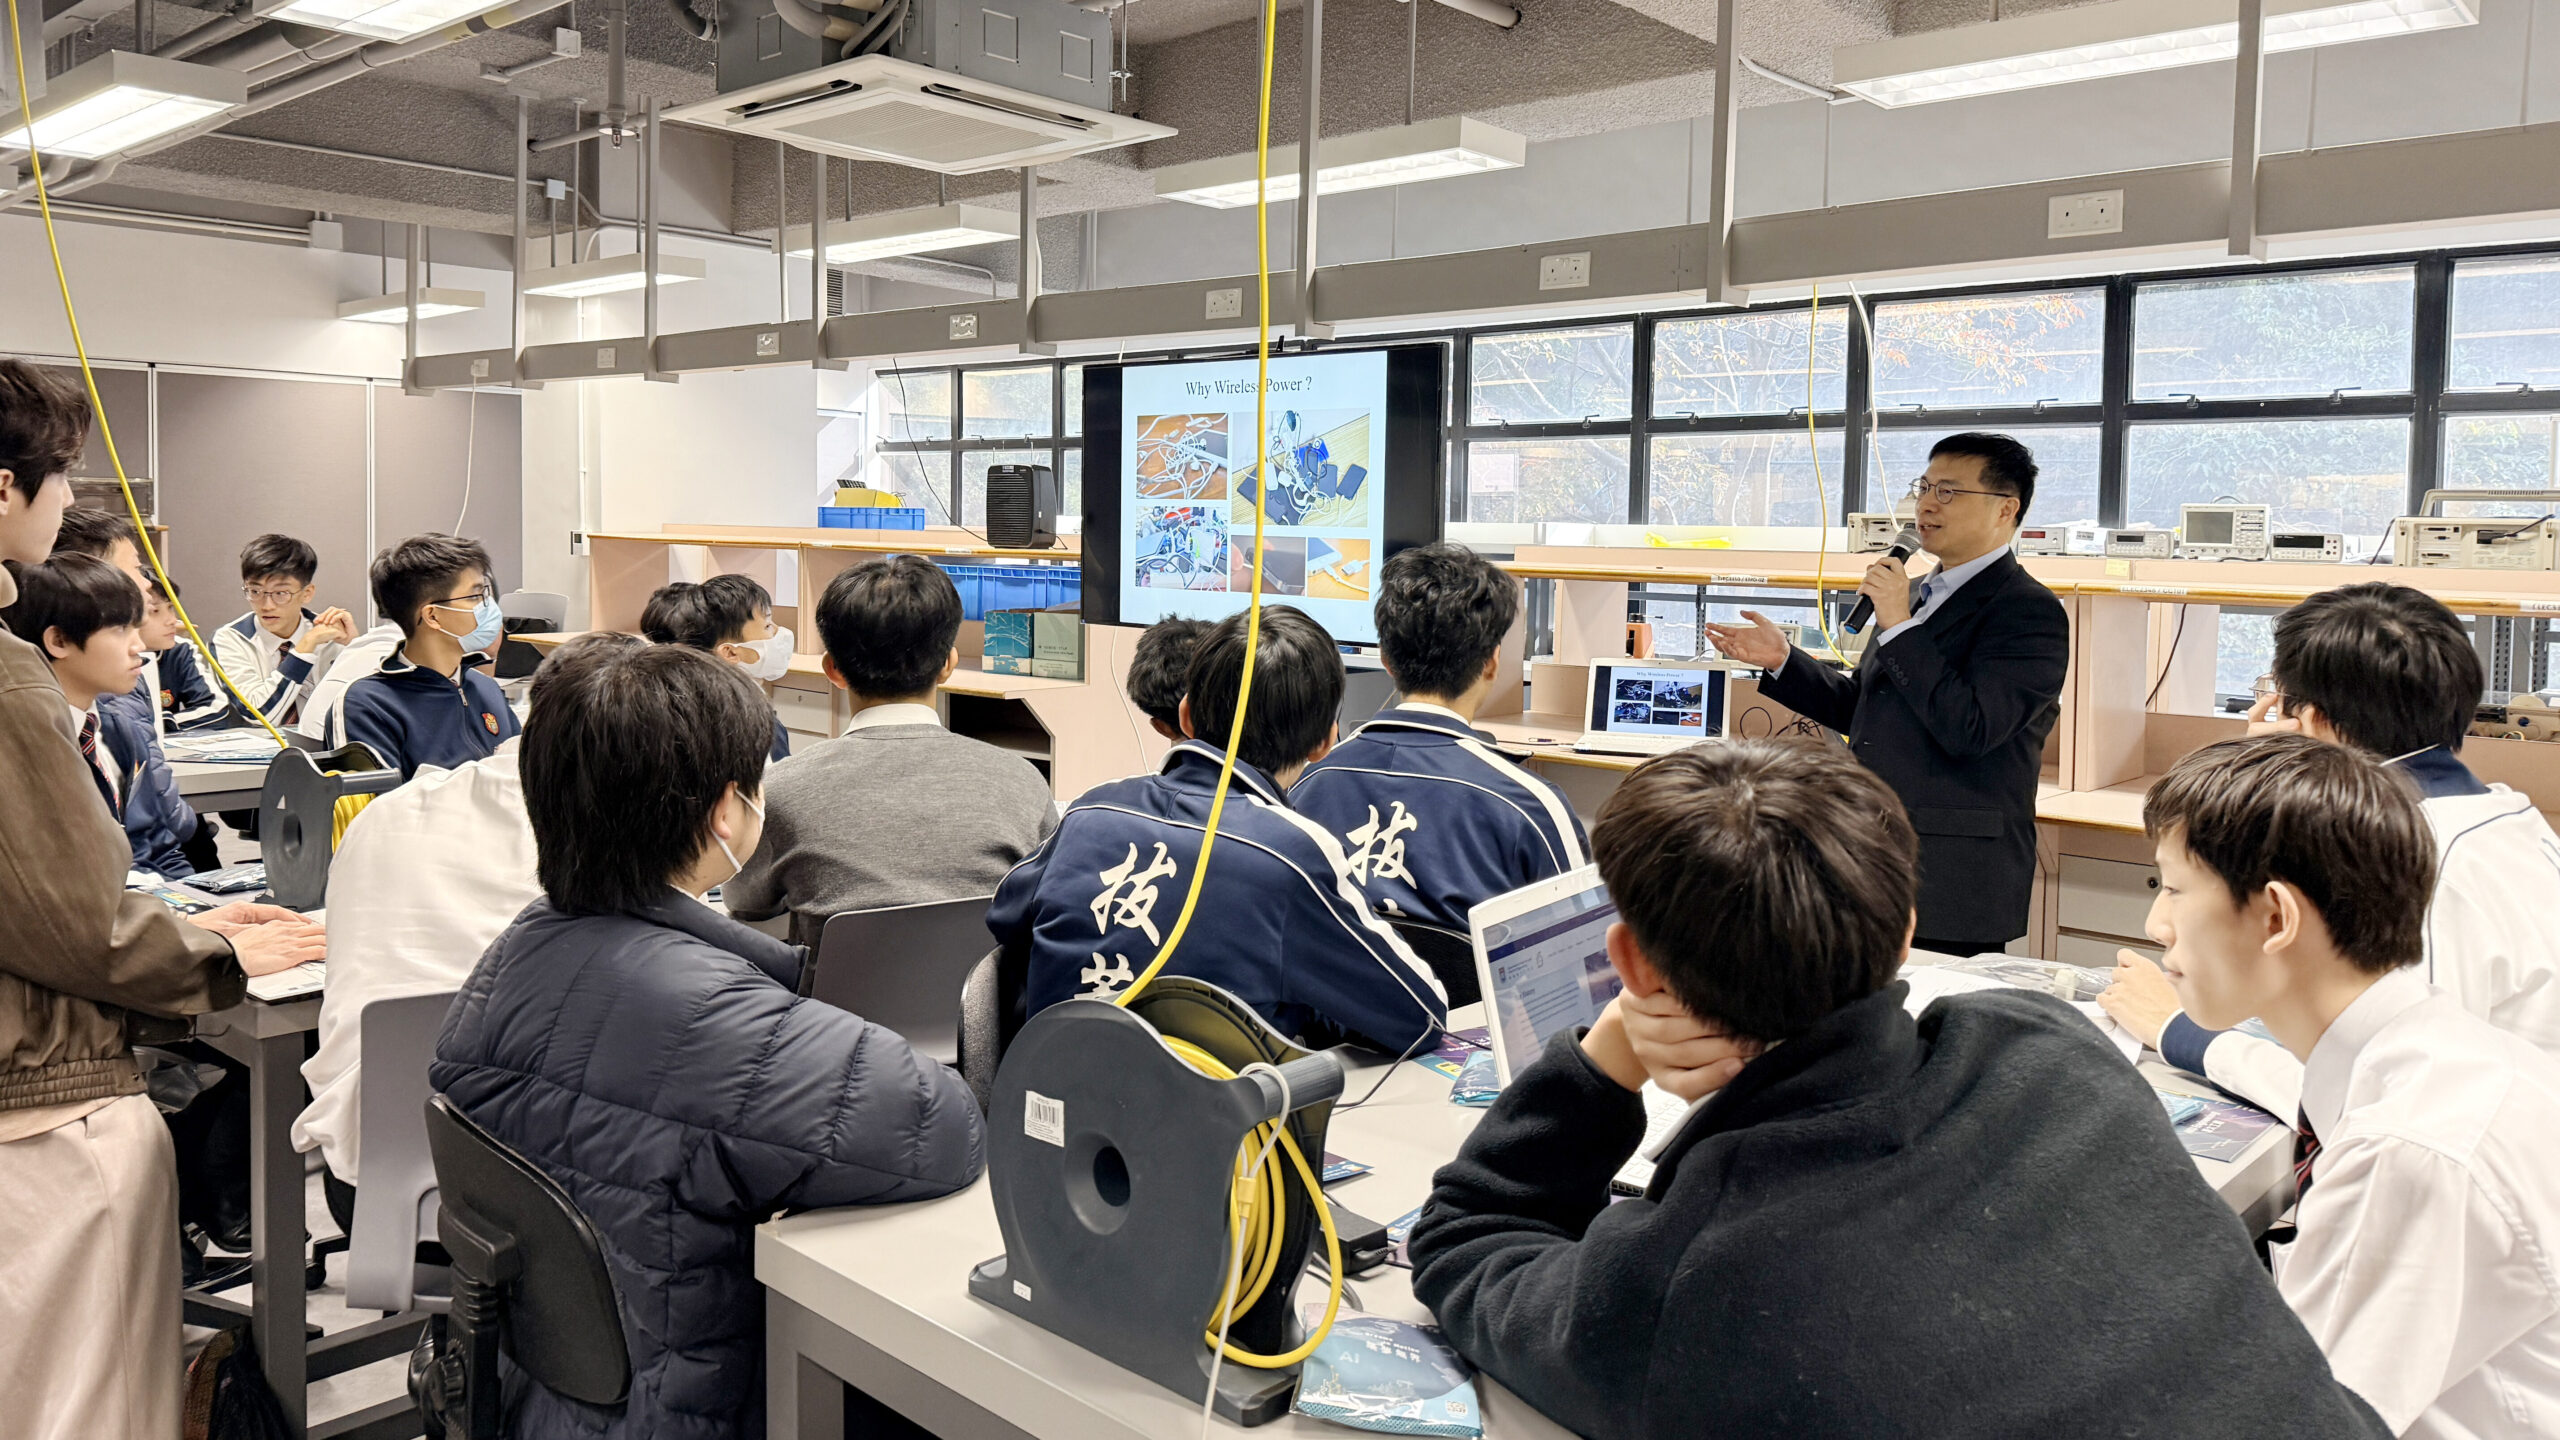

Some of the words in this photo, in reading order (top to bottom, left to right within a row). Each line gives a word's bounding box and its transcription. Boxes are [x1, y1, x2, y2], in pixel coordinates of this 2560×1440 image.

[1186, 381, 1211, 399] Why
[1266, 378, 1302, 393] Power
[1305, 375, 1312, 391] ?
[1346, 801, 1418, 917] 拔
